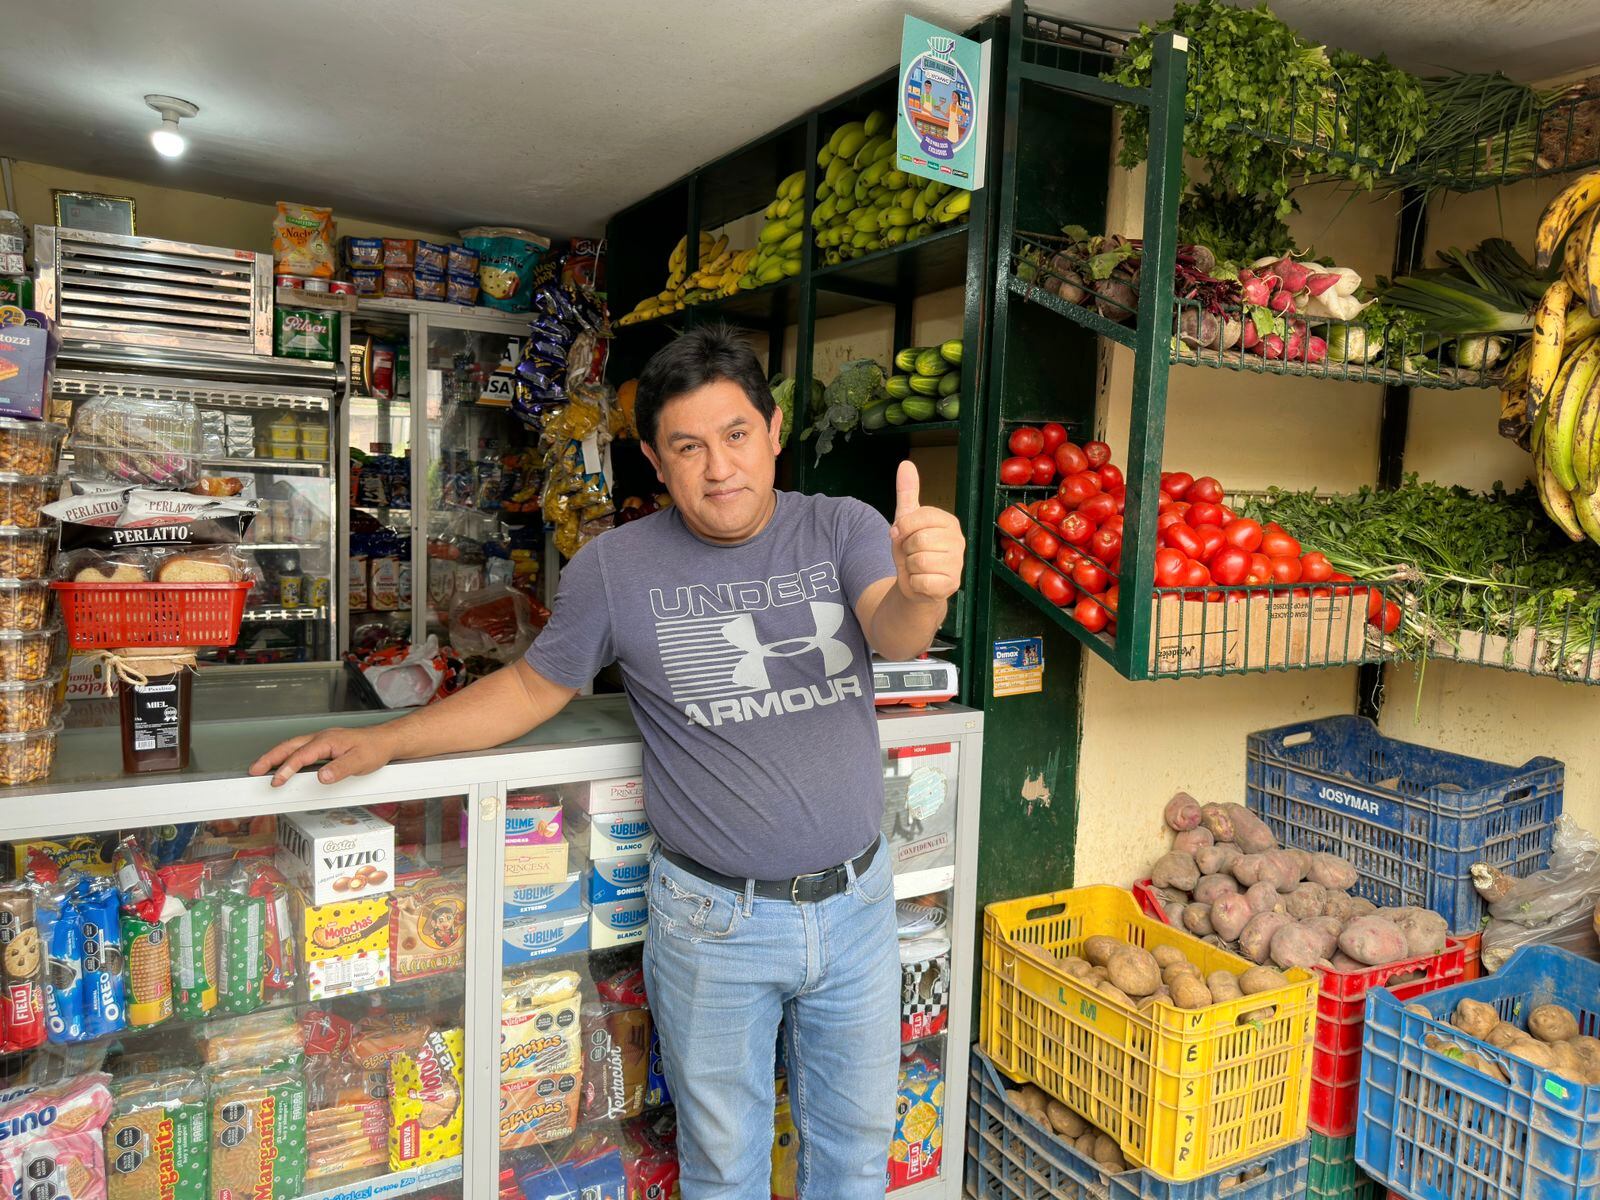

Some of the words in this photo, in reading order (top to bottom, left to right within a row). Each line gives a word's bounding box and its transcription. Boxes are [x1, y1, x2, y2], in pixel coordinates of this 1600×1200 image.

[65, 501, 119, 521] PERLATTO
[114, 526, 189, 545] PERLATTO
[650, 561, 840, 620] UNDER
[146, 701, 168, 709] MIEL
[684, 675, 863, 727] ARMOUR
[1318, 787, 1380, 816] JOSYMAR
[505, 817, 535, 830] BLIME
[323, 838, 356, 854] Costa
[616, 843, 642, 851] BLANCO
[323, 848, 386, 871] VIZZIO
[513, 885, 554, 901] SUBLIME
[520, 904, 547, 913] EXTREMO
[324, 915, 374, 941] Morochas
[344, 931, 362, 944] TACO
[523, 927, 564, 944] SUBLIME
[617, 930, 642, 940] BLANCO
[530, 947, 557, 957] EXTREMO
[15, 989, 28, 1021] FIELD
[99, 972, 119, 1022] OREO
[46, 984, 65, 1034] OREO
[608, 1045, 627, 1120] Tentación
[153, 1117, 180, 1200] rgarita
[253, 1096, 278, 1200] Margarita
[912, 1146, 921, 1173] FIELD
